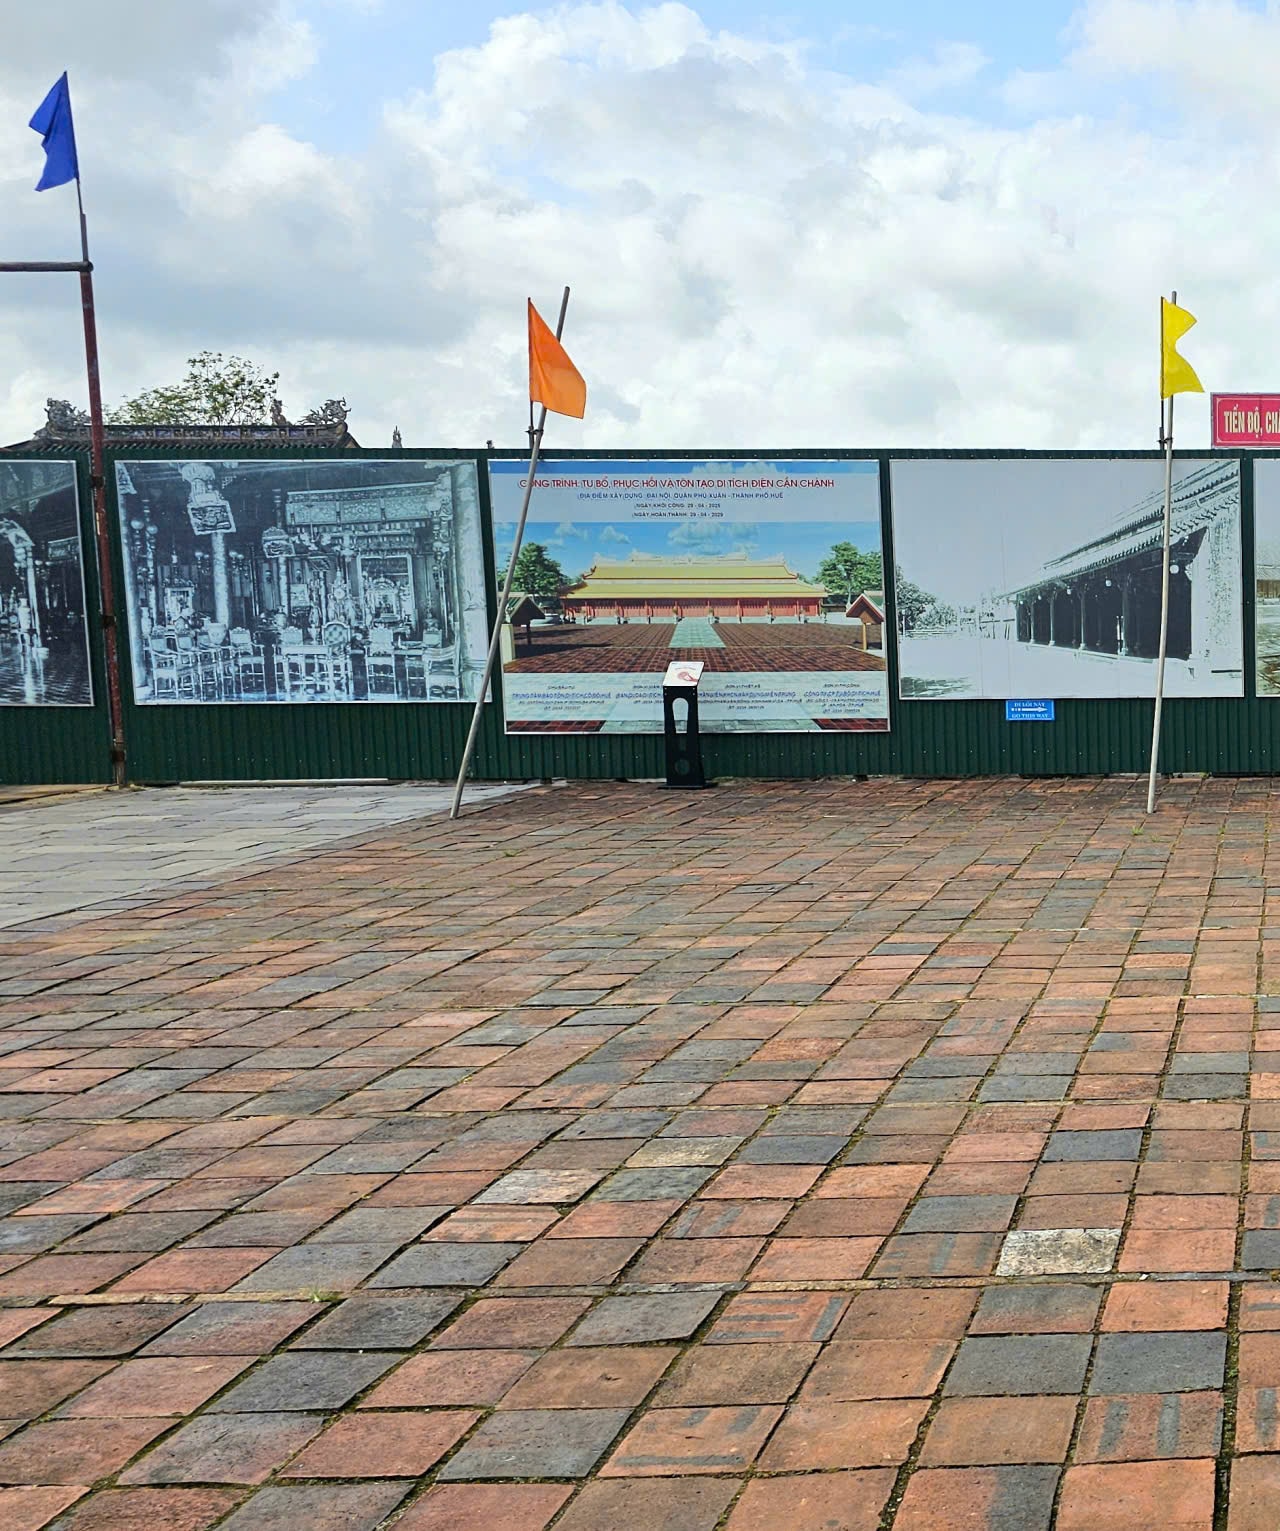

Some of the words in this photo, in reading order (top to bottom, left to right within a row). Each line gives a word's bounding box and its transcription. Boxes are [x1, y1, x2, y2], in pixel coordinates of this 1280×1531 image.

[1224, 404, 1245, 433] TIẾN
[1247, 407, 1263, 438] ĐỘ,
[519, 479, 550, 488] CNG
[582, 479, 594, 488] TU
[613, 479, 640, 490] PHỤC
[660, 477, 674, 488] VÀ
[675, 477, 695, 488] TÔN
[697, 479, 715, 490] TẠO
[717, 479, 726, 488] DI
[728, 477, 749, 488] TÍCH
[751, 477, 774, 490] ĐIỆN
